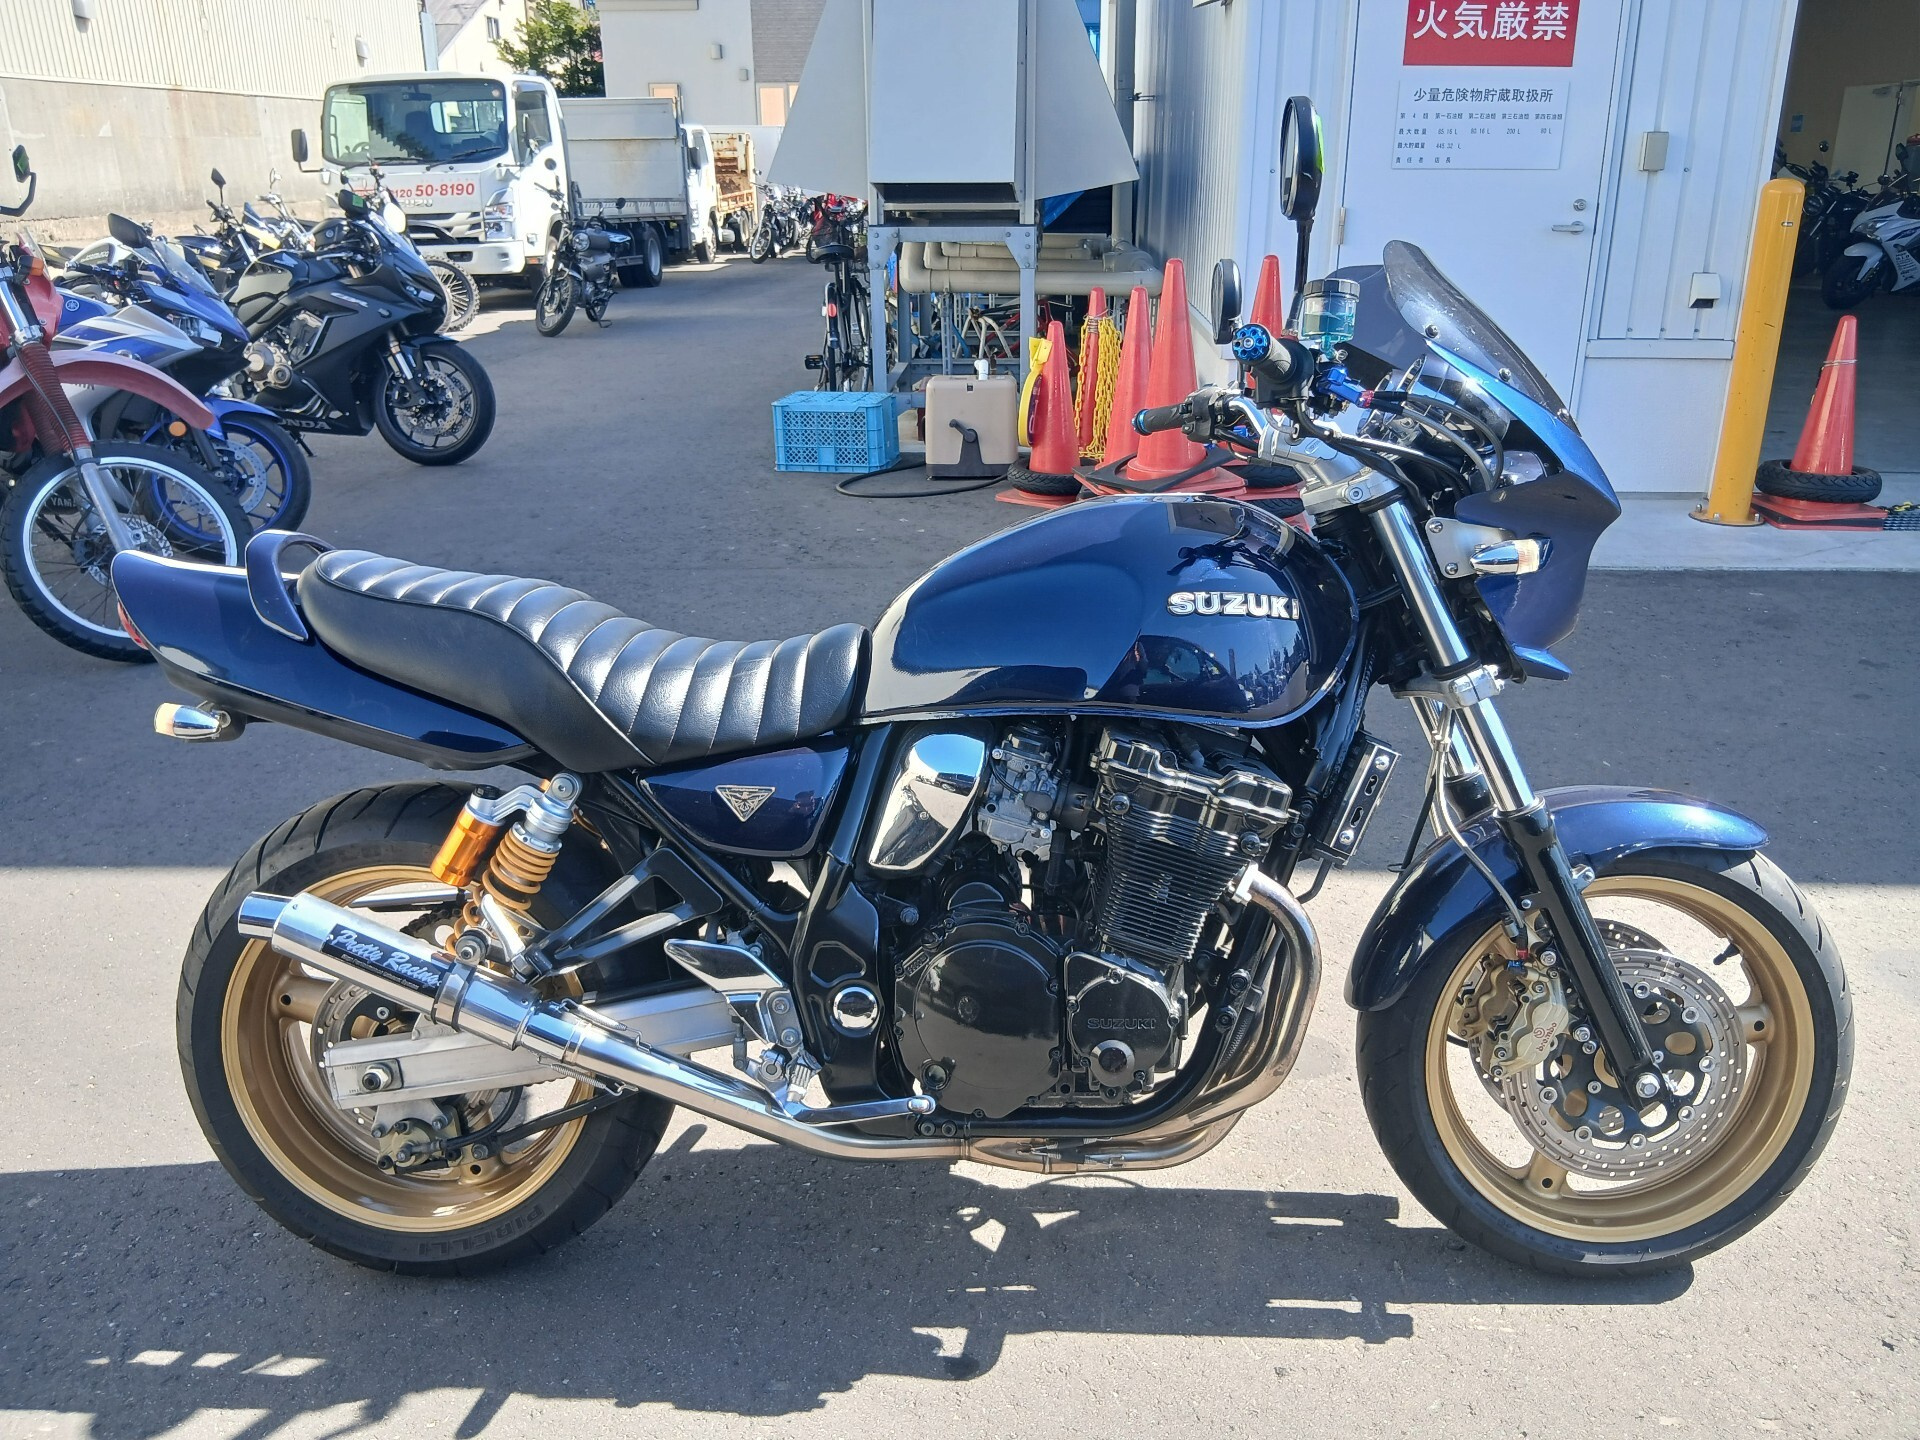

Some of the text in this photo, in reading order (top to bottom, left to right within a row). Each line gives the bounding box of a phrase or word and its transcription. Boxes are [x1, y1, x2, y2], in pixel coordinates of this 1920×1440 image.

[1413, 1, 1569, 41] 火気厳禁
[1413, 88, 1553, 103] 少量危険物貯蔵取扱所
[1168, 591, 1300, 620] SUZUKI
[332, 929, 384, 965] Pretty
[1087, 1017, 1157, 1030] SUZUKI
[1535, 1022, 1558, 1052] brembo
[417, 1204, 545, 1257] PIRELLI
